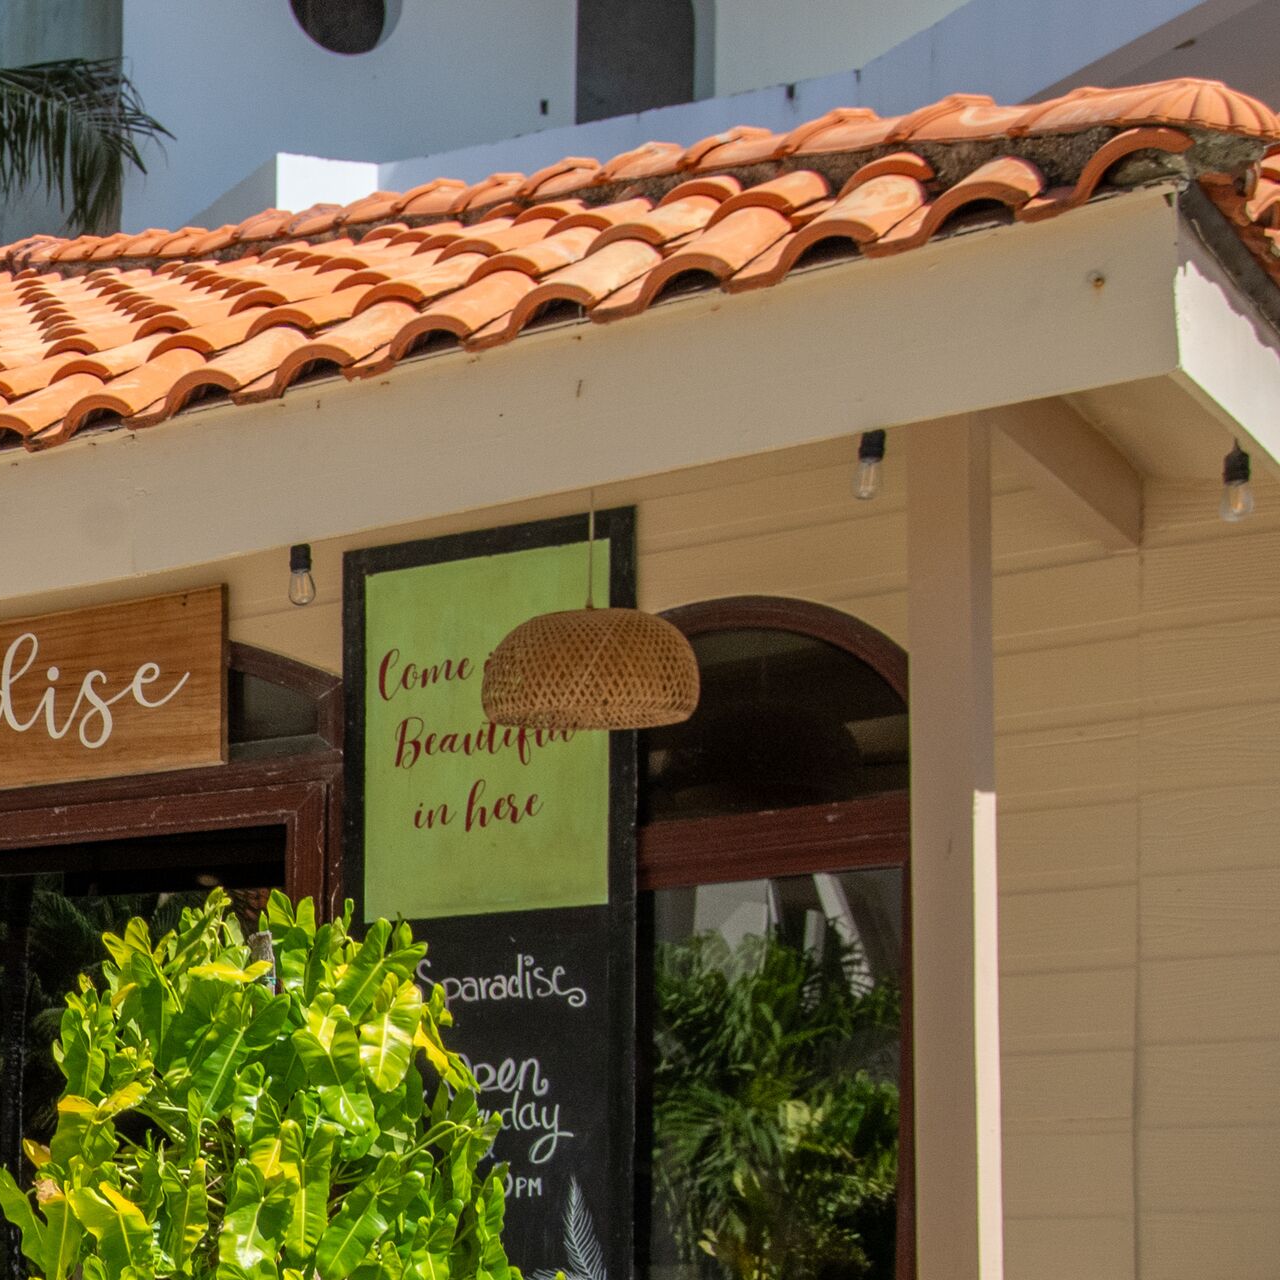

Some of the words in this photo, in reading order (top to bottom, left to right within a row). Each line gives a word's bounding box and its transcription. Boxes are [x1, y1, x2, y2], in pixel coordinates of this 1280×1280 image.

[378, 648, 476, 702] Come
[414, 802, 458, 829] in
[465, 779, 545, 832] here
